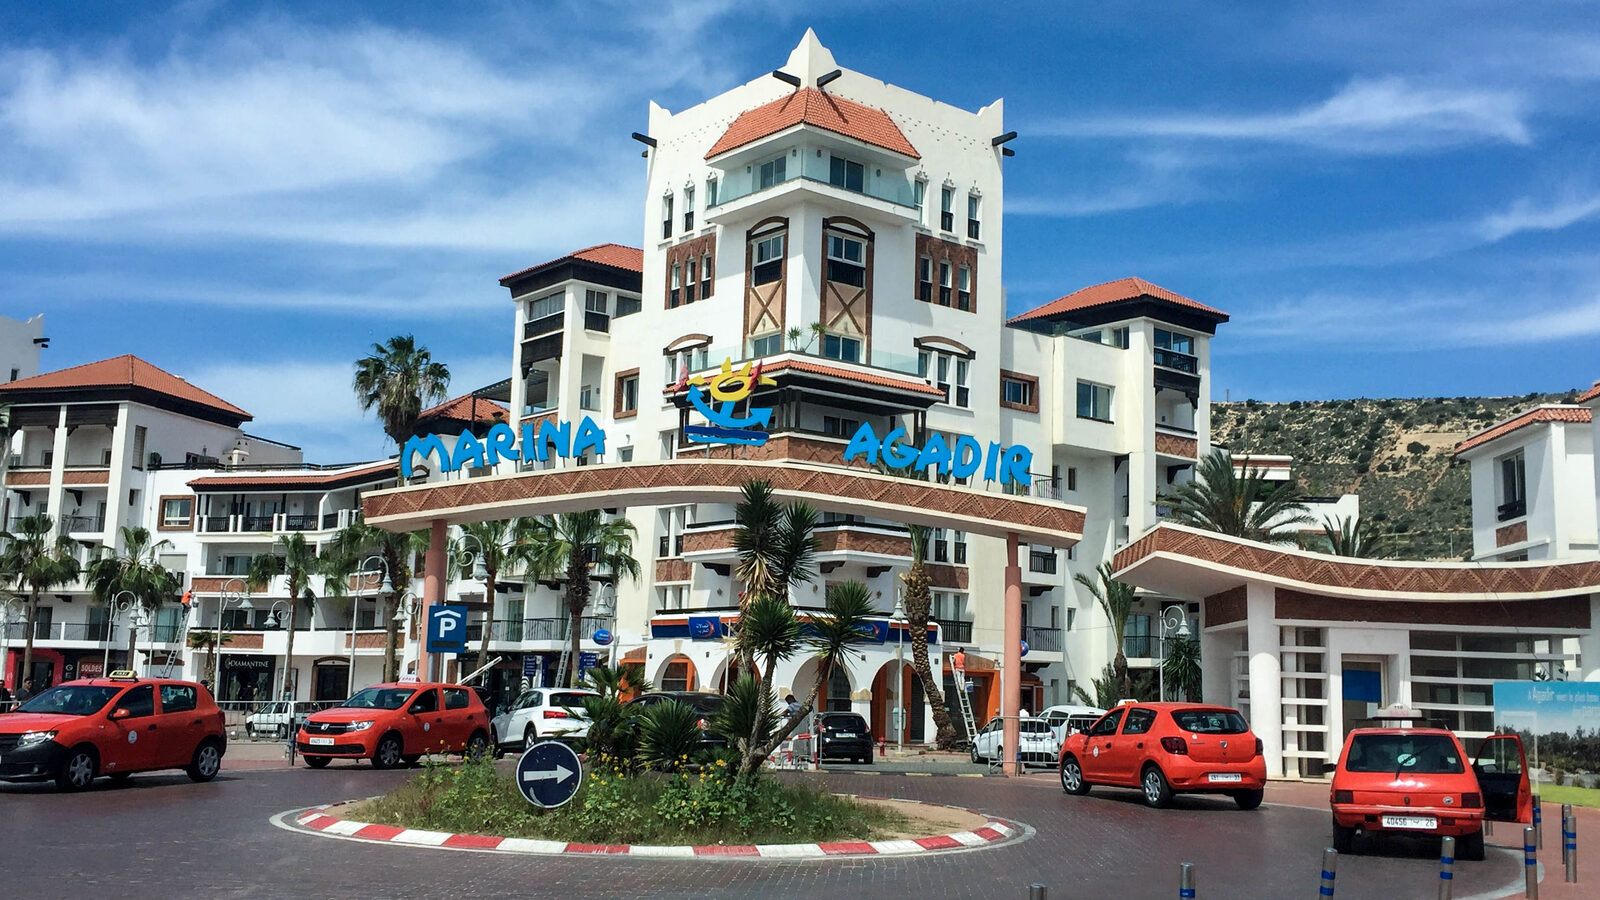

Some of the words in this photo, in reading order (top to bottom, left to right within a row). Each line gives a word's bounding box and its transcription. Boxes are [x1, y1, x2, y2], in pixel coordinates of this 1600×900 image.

[401, 416, 606, 477] MARINA
[843, 422, 1032, 486] AGADIR
[439, 617, 457, 638] P
[81, 664, 102, 673] SOLDES
[1386, 817, 1408, 826] 40456
[1425, 819, 1435, 827] 26
